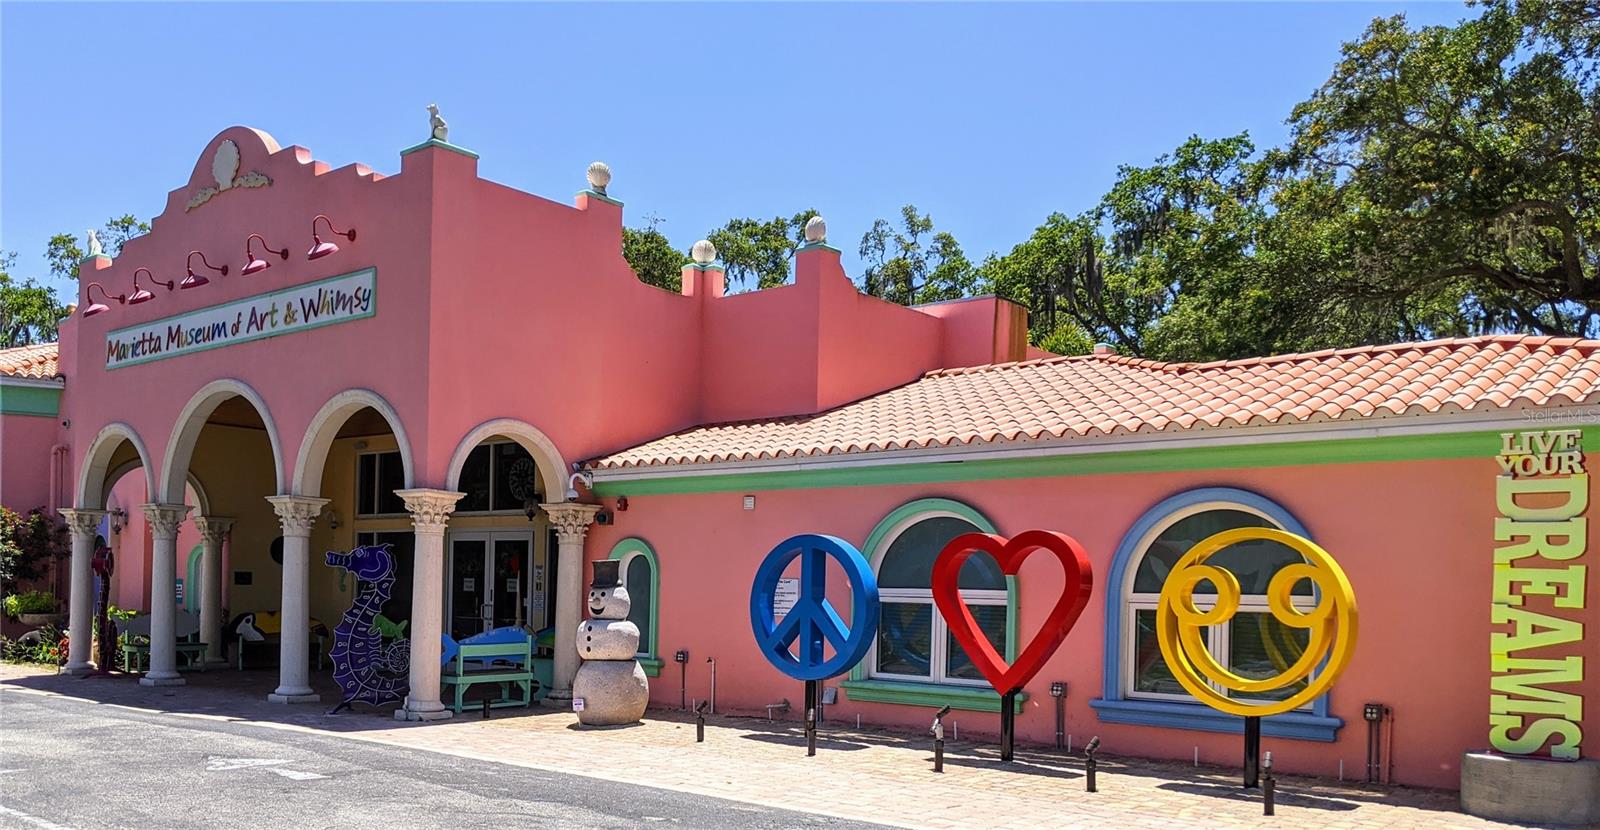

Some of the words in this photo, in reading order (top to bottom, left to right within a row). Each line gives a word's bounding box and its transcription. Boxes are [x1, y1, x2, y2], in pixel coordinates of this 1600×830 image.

[106, 332, 162, 364] Marietta
[166, 320, 227, 351] Museum
[230, 312, 242, 336] of
[246, 302, 279, 334] Art
[284, 301, 299, 326] &
[300, 286, 372, 323] Whimsy
[1495, 450, 1586, 477] YOUR
[1500, 429, 1582, 456] LIVE
[1488, 473, 1590, 761] DREAMS
